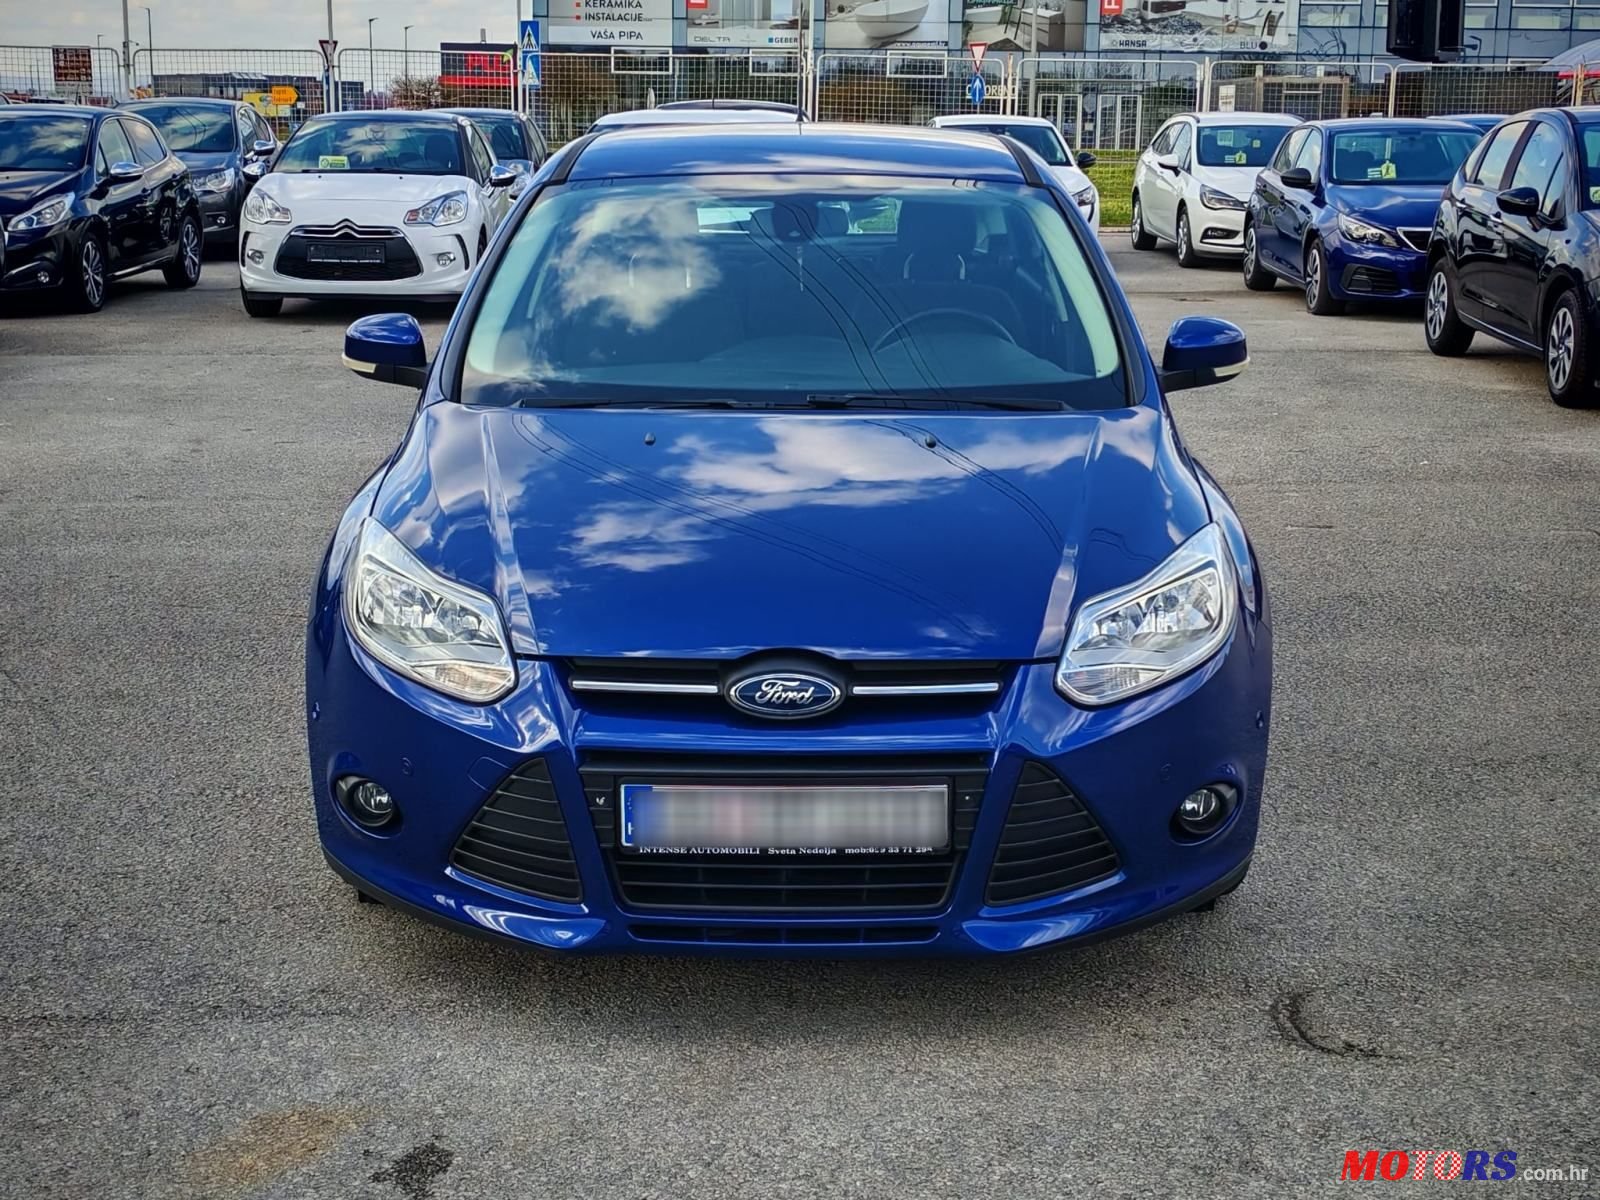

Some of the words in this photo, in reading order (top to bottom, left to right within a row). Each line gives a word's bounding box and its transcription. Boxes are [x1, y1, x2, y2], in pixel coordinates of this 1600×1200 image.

[585, 0, 643, 8] KERAMIKA
[590, 29, 615, 40] VAŠA
[619, 31, 643, 40] PIPA
[755, 680, 815, 704] Ford
[689, 847, 760, 855] AUTOMOBILI
[767, 847, 797, 855] Sveta
